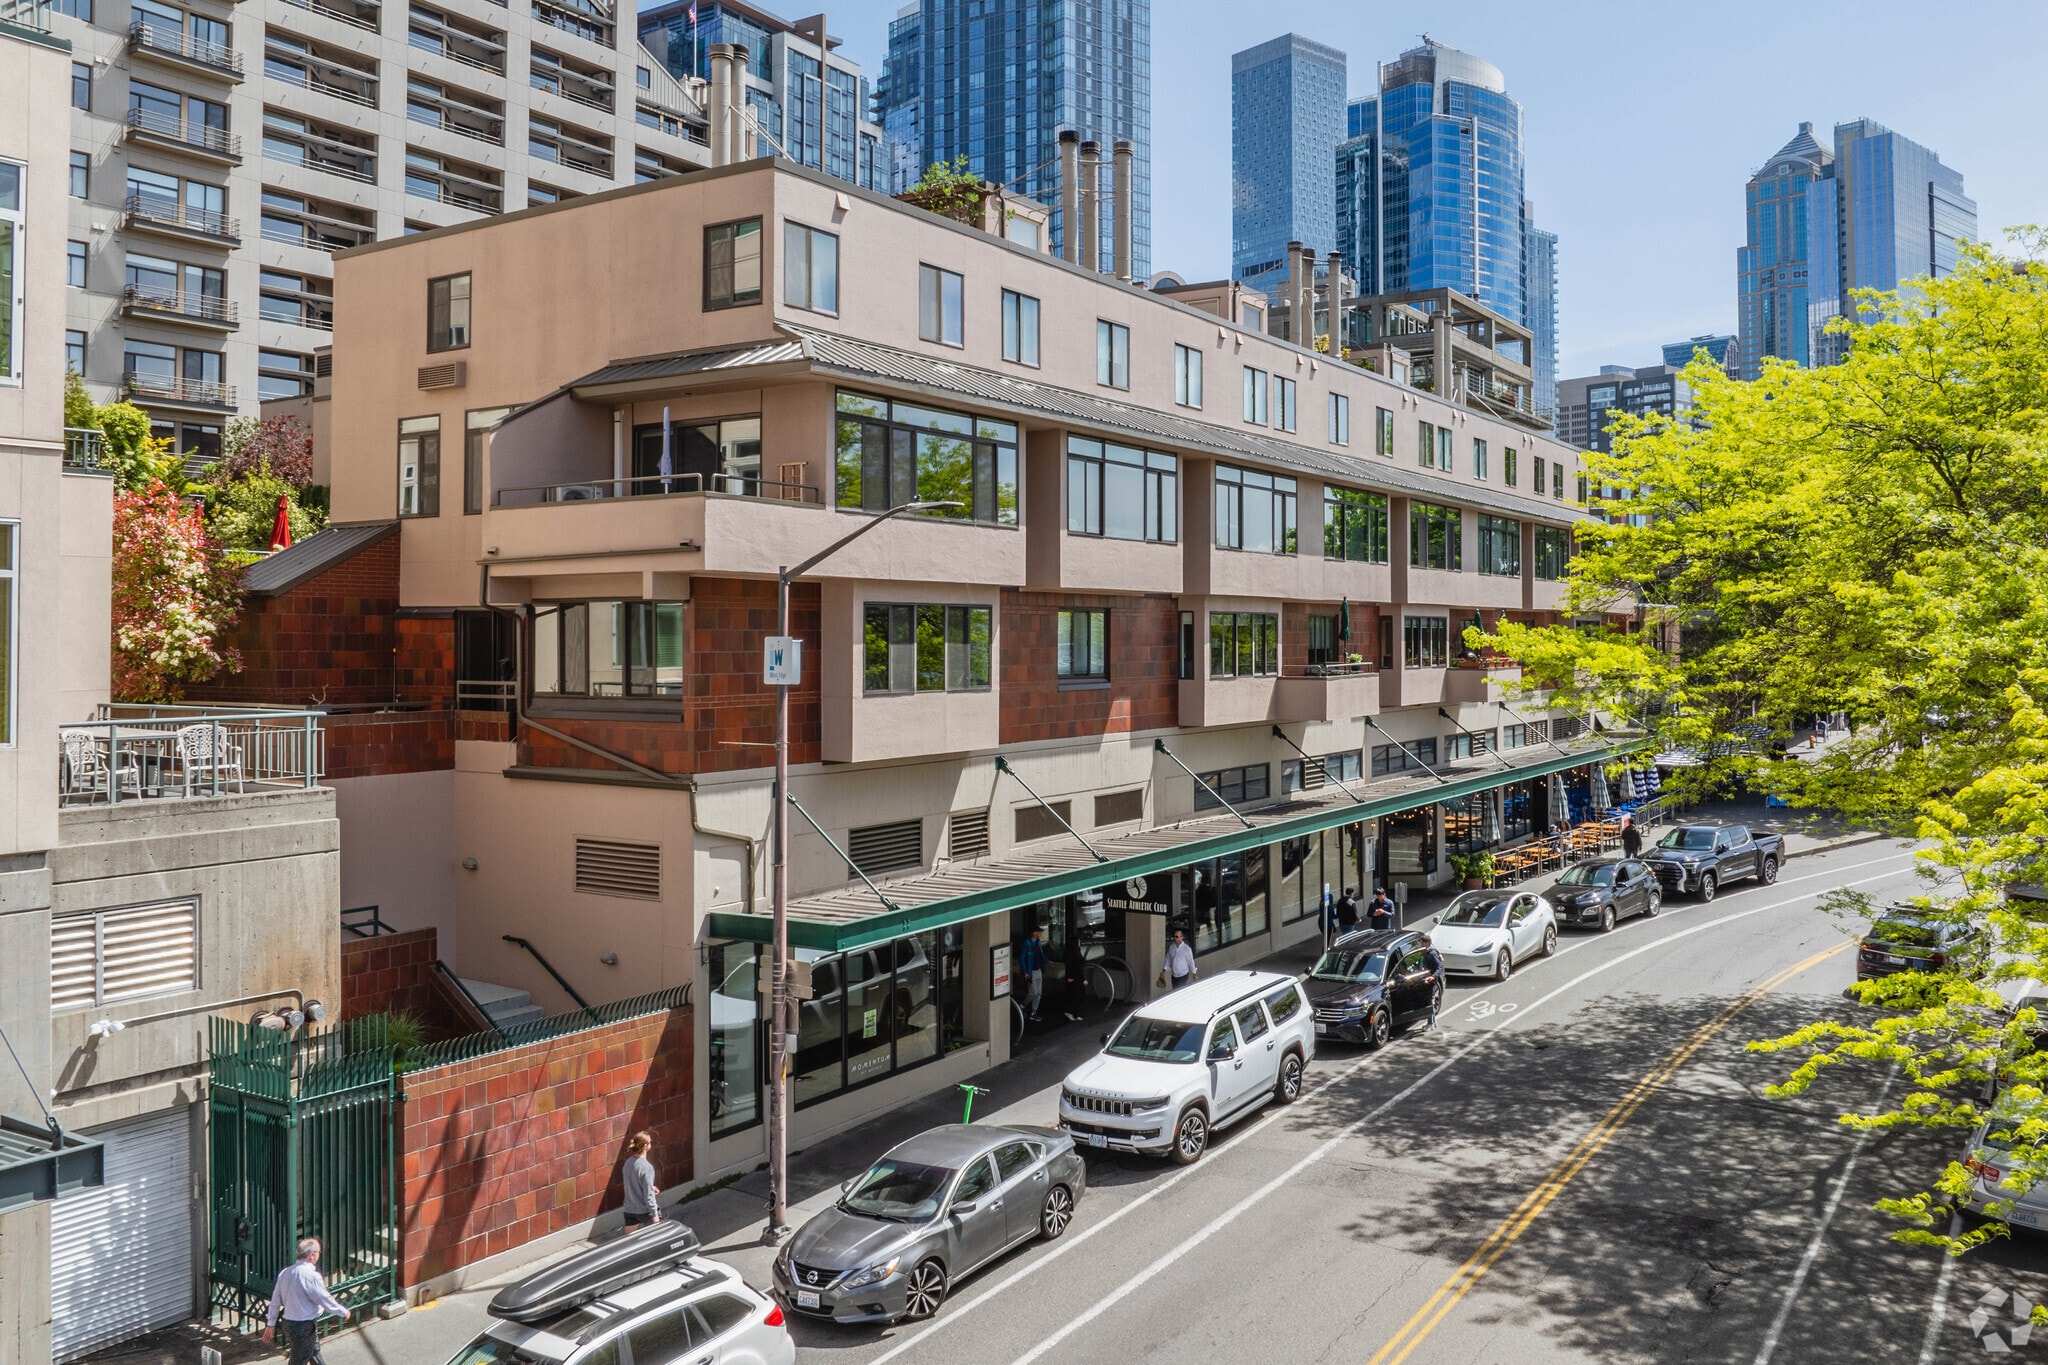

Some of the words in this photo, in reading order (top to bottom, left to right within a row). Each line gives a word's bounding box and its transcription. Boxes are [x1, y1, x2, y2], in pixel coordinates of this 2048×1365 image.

[1107, 898, 1127, 909] SEATTLE
[1128, 899, 1152, 912] ATHLETIC
[1153, 902, 1168, 913] CLUB
